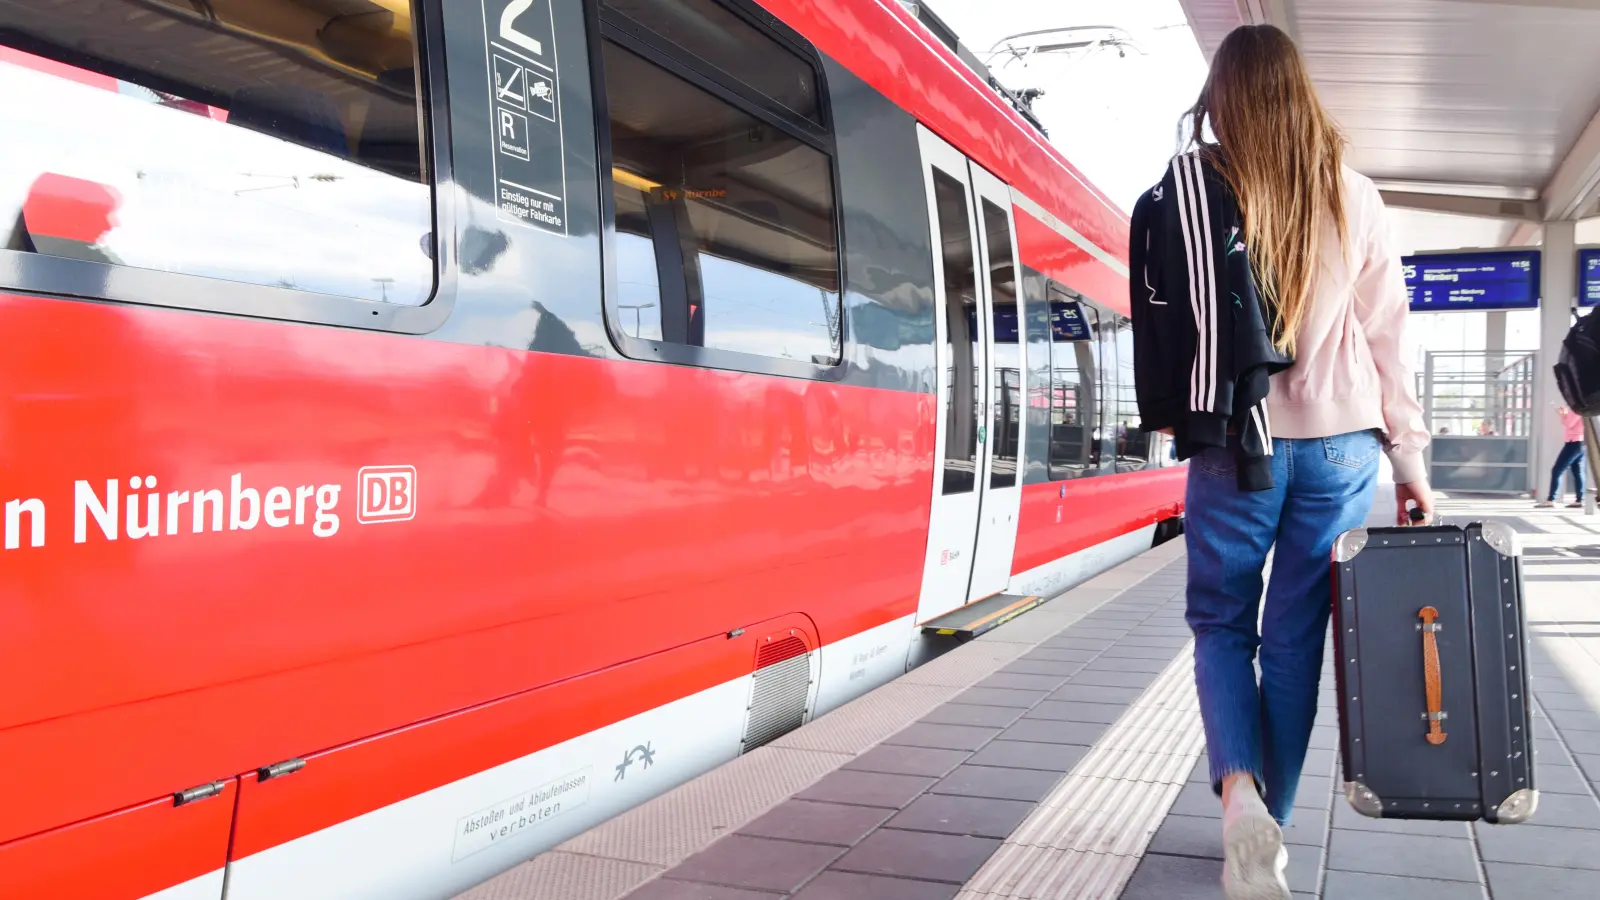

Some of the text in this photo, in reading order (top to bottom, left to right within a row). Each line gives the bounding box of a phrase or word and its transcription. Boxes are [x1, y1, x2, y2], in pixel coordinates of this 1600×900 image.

[499, 0, 542, 56] 2
[501, 111, 515, 140] R
[501, 140, 527, 155] Reservation
[501, 188, 554, 213] Einstieg nur mit
[501, 202, 562, 227] gültiger Fahrkarte
[4, 472, 341, 550] n Nürnberg
[463, 774, 587, 836] Abstoßen und Ablaufenlassen
[489, 801, 561, 841] verboten
